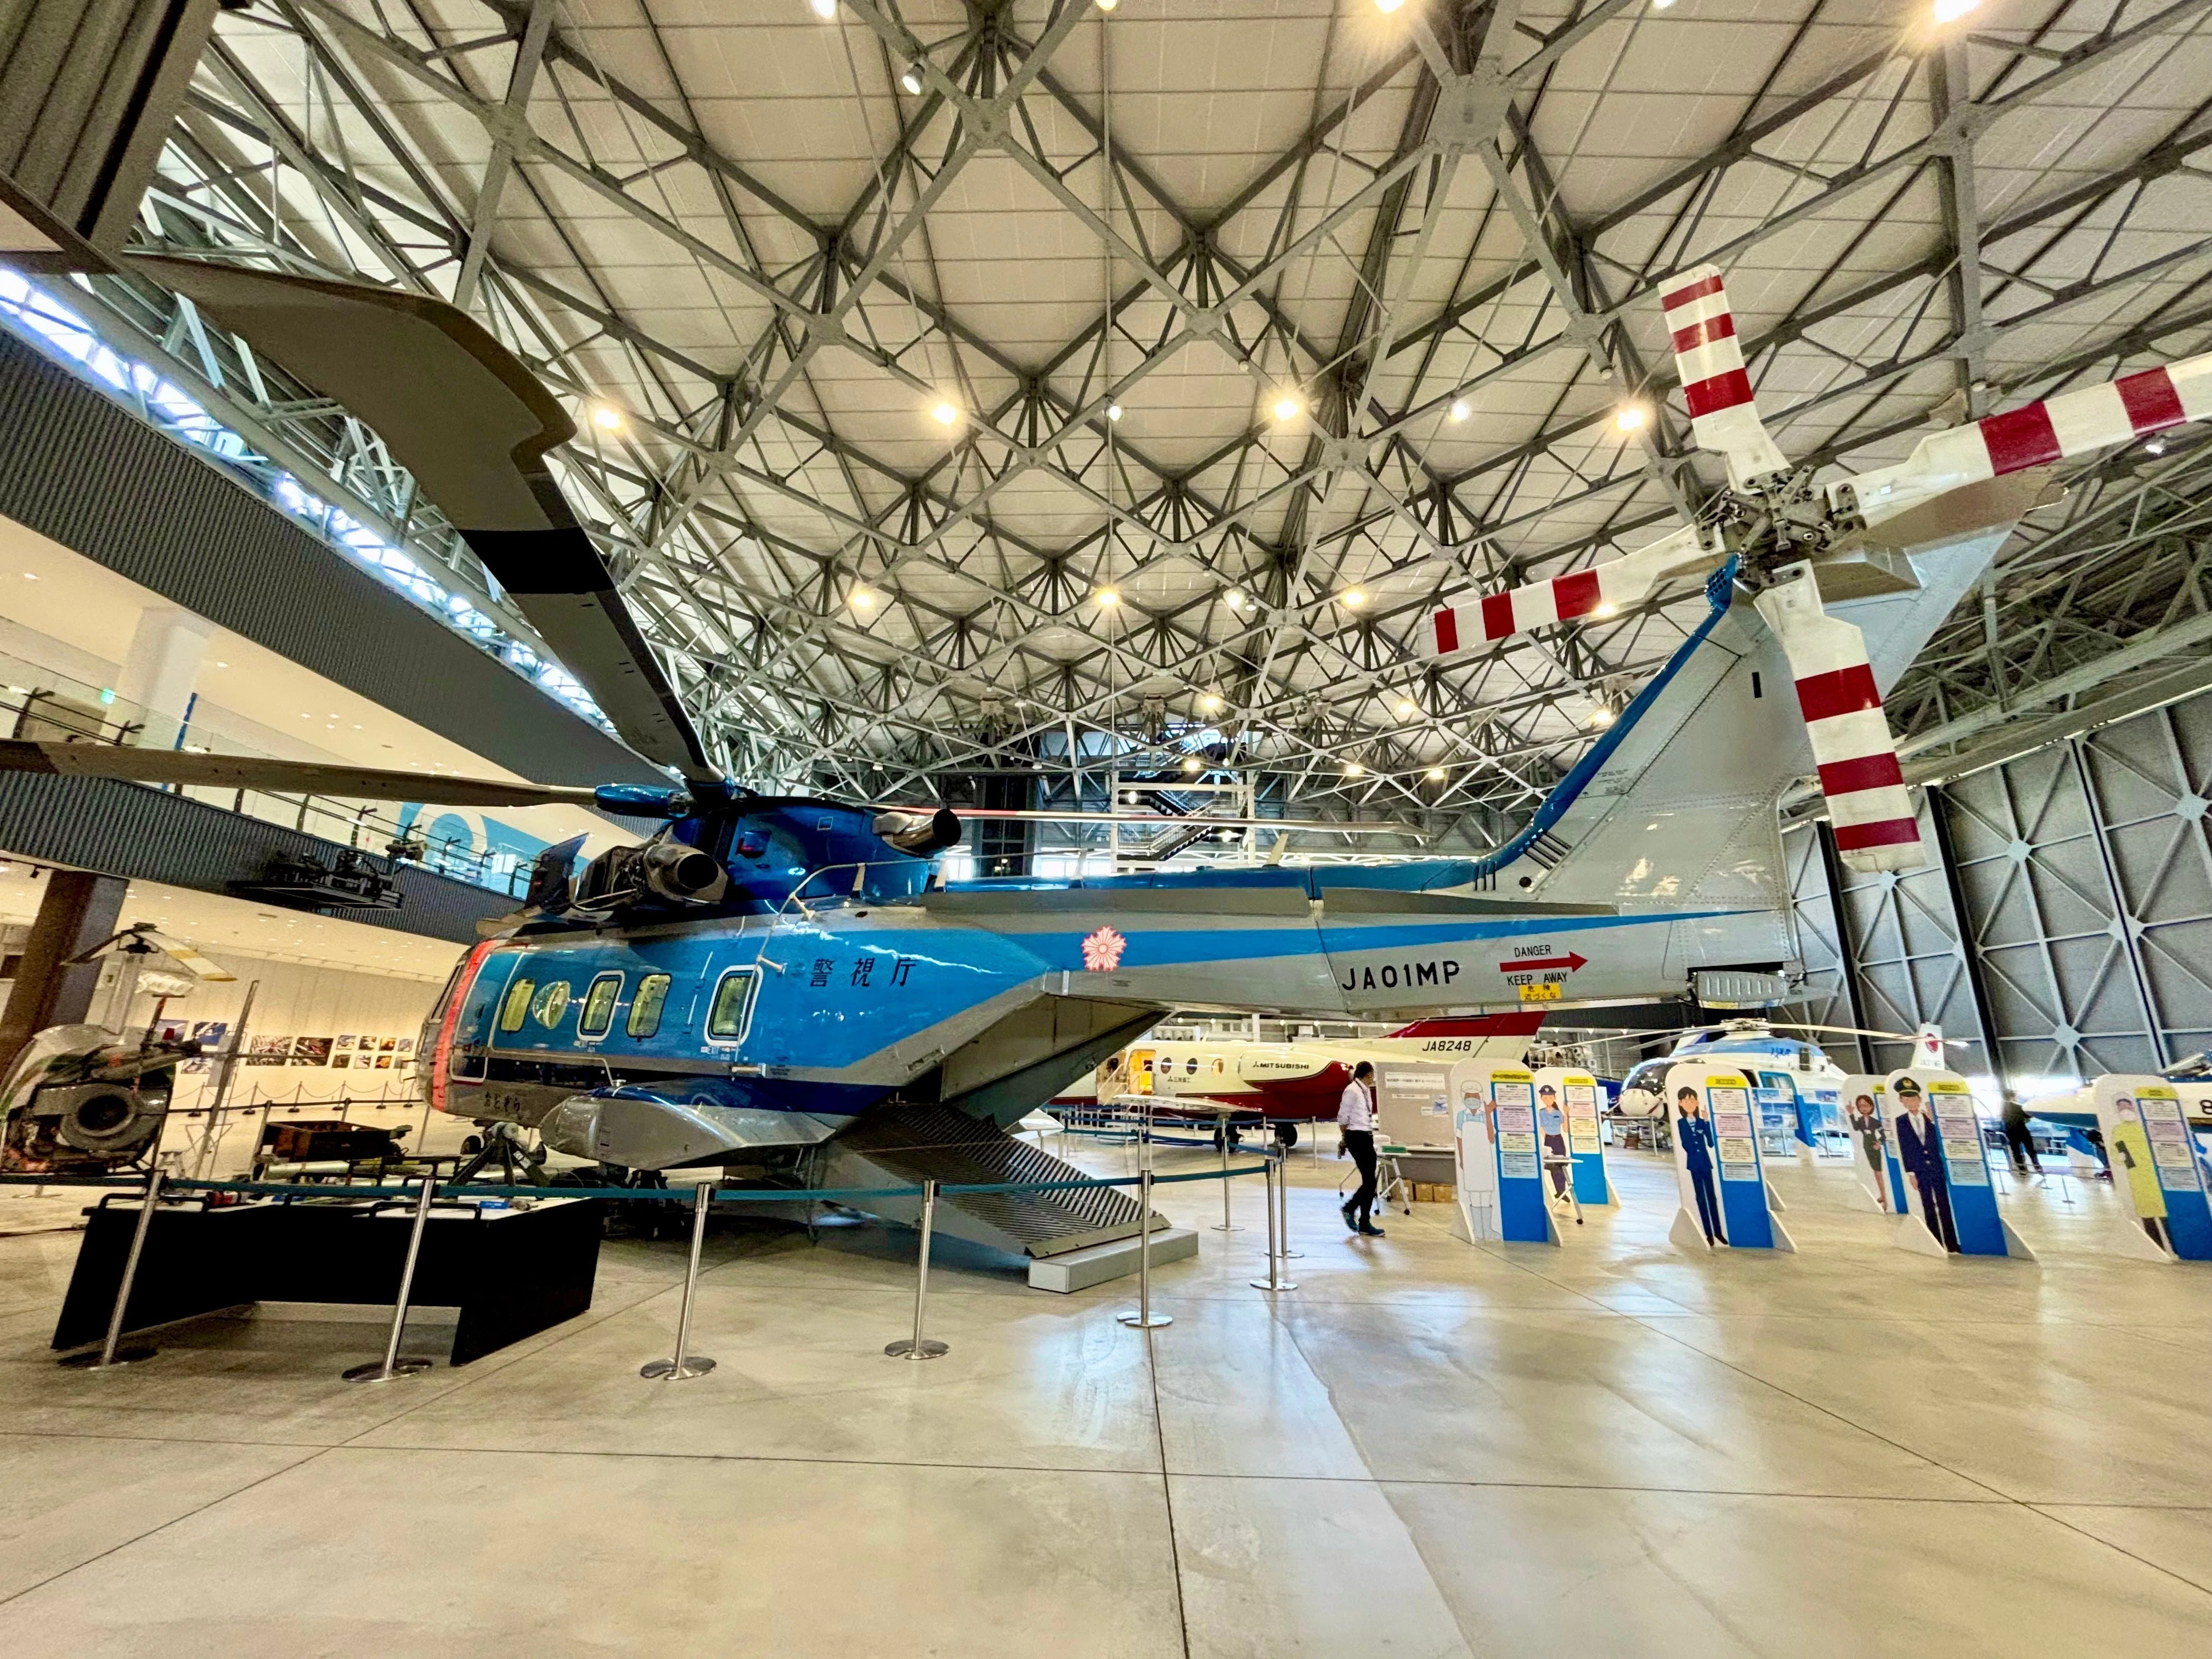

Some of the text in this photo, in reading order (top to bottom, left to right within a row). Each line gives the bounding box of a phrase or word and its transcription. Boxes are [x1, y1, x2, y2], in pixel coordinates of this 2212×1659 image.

[1514, 945, 1551, 957] DANGER
[810, 957, 919, 987] 警視庁
[1342, 961, 1459, 991] JA01MP
[1507, 972, 1567, 986] KEEP AWAY
[1527, 984, 1550, 992] 危険
[1525, 992, 1557, 1000] 近づくな
[1422, 1041, 1471, 1052] JA8248
